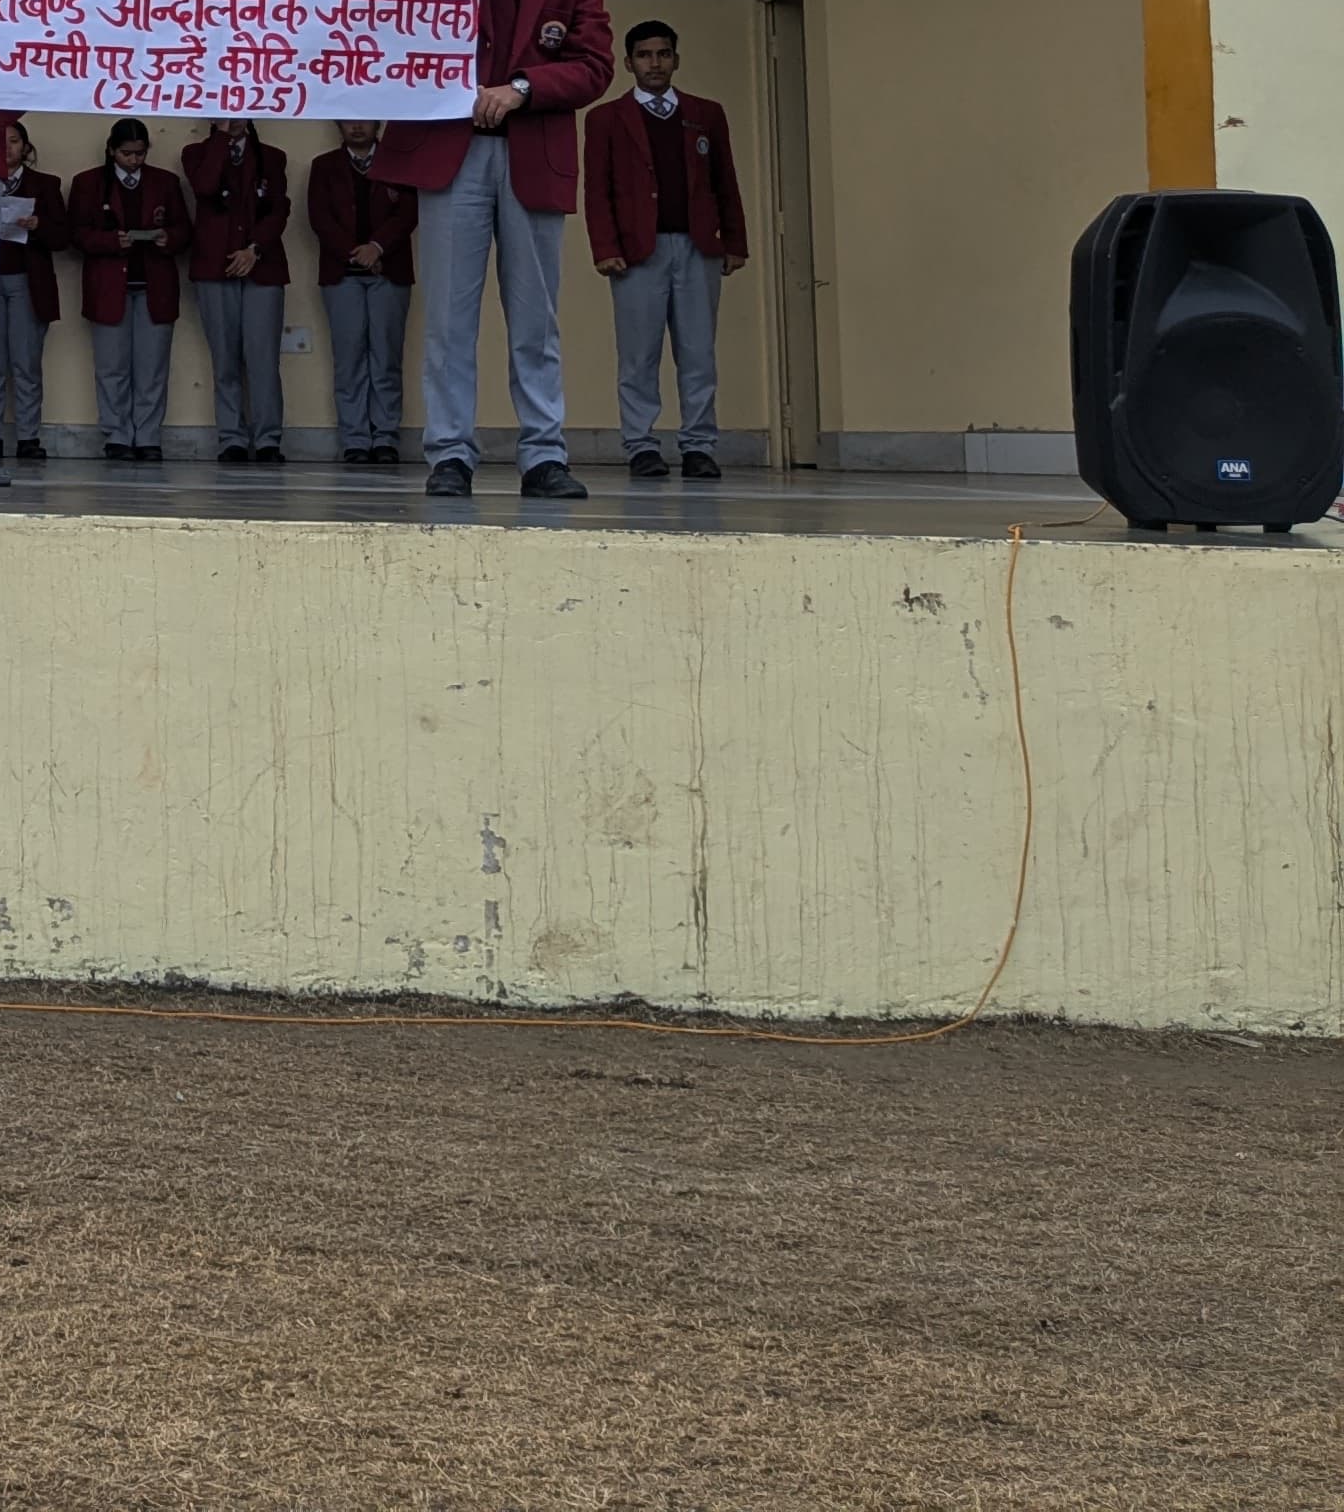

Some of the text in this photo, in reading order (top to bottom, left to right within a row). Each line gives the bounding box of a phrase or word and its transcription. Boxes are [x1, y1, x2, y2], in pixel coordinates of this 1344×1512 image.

[94, 46, 138, 80] पर
[140, 34, 207, 83] उन्हें
[386, 52, 473, 90] नमन
[94, 79, 307, 116] (24-12-1925)
